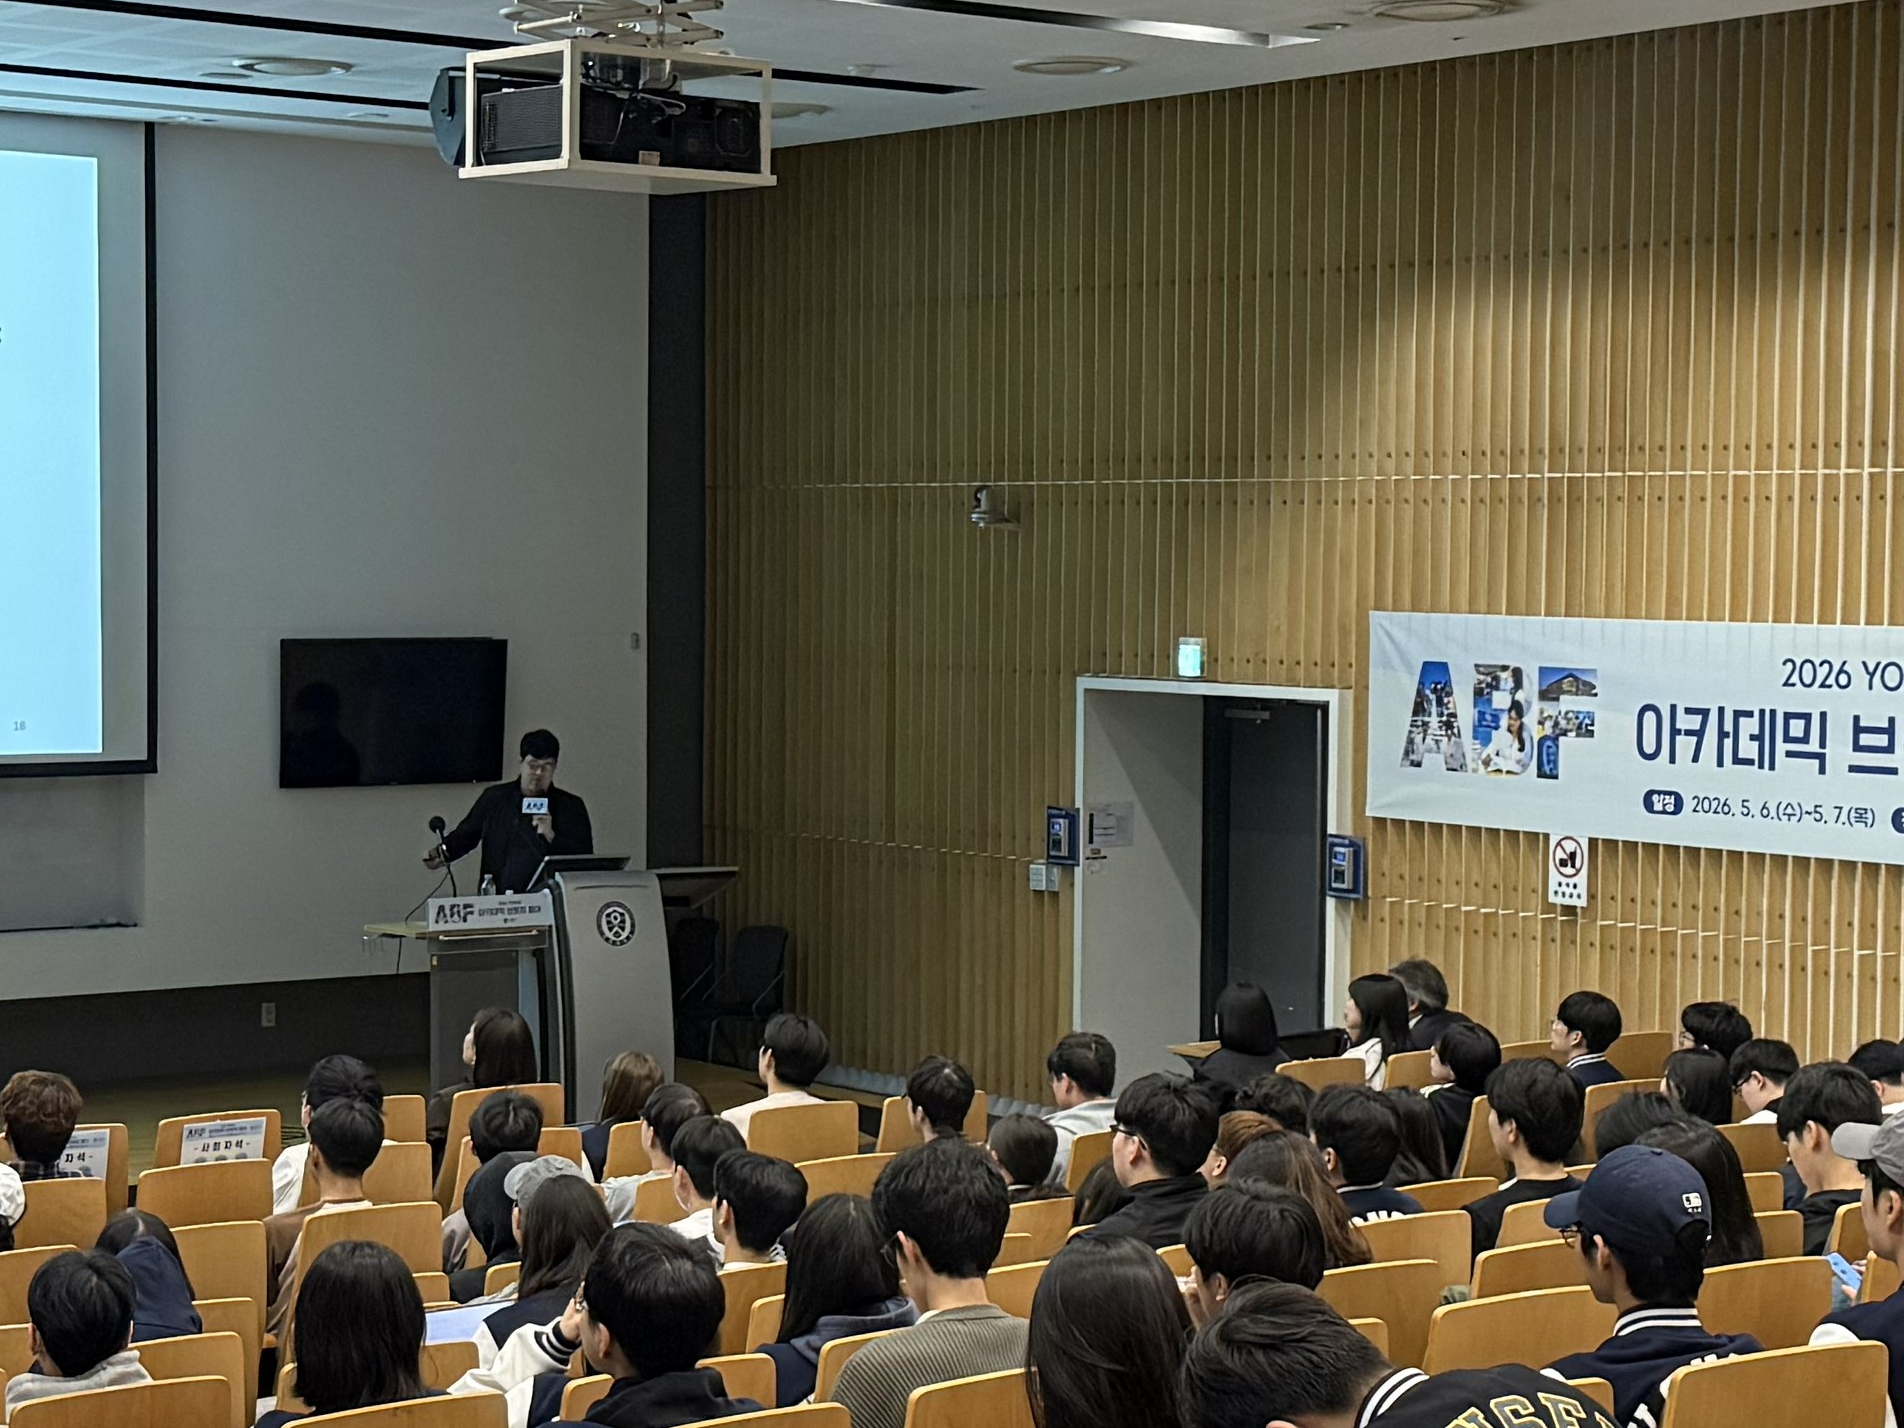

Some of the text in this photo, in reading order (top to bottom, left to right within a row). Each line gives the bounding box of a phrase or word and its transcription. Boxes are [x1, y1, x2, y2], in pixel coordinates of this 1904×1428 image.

[1781, 658, 1852, 690] 2026
[1399, 660, 1598, 780] ABF
[1636, 703, 1828, 775] 아카데믹
[1691, 795, 1736, 817] 2026.
